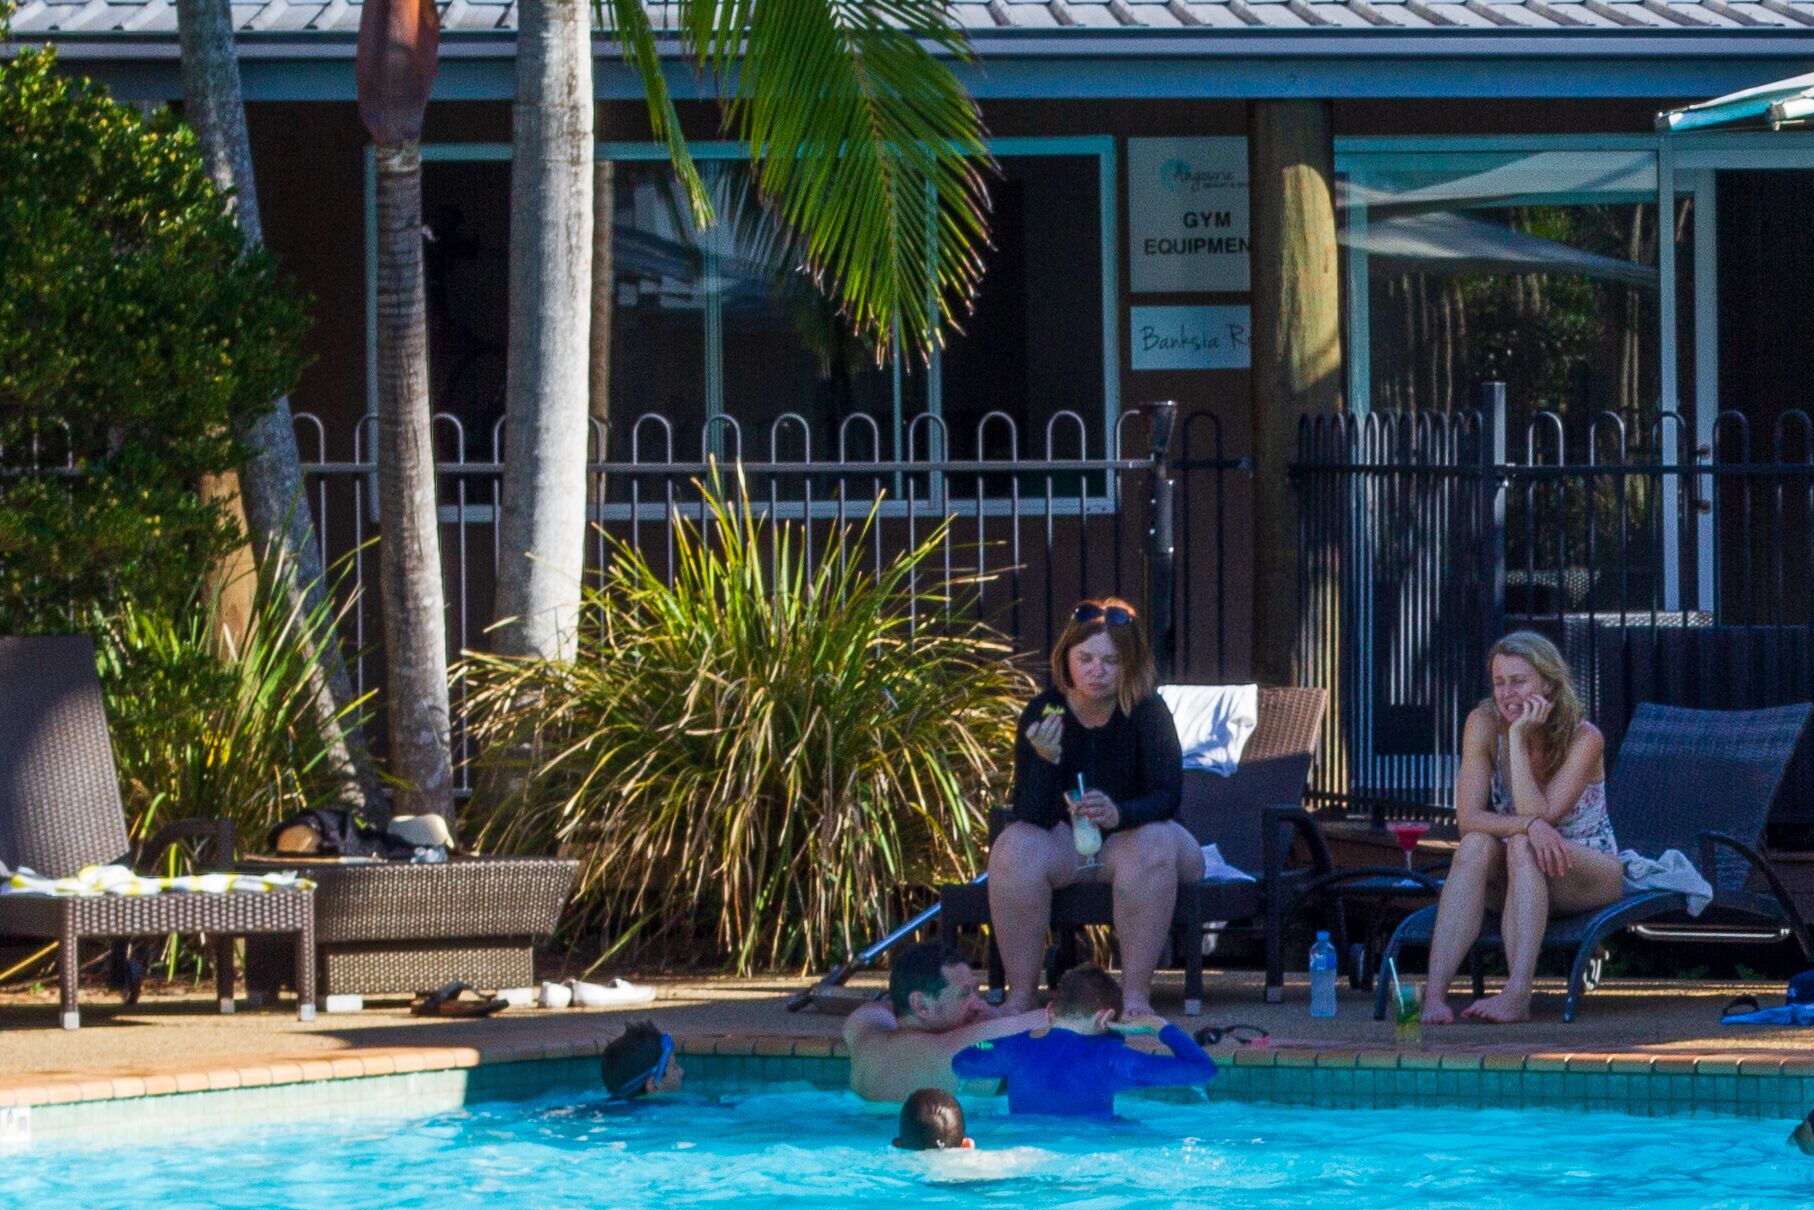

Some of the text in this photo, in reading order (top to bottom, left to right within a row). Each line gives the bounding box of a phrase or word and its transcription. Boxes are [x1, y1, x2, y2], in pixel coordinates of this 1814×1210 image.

[1182, 211, 1232, 229] GYM
[1139, 323, 1250, 351] Banksia R
